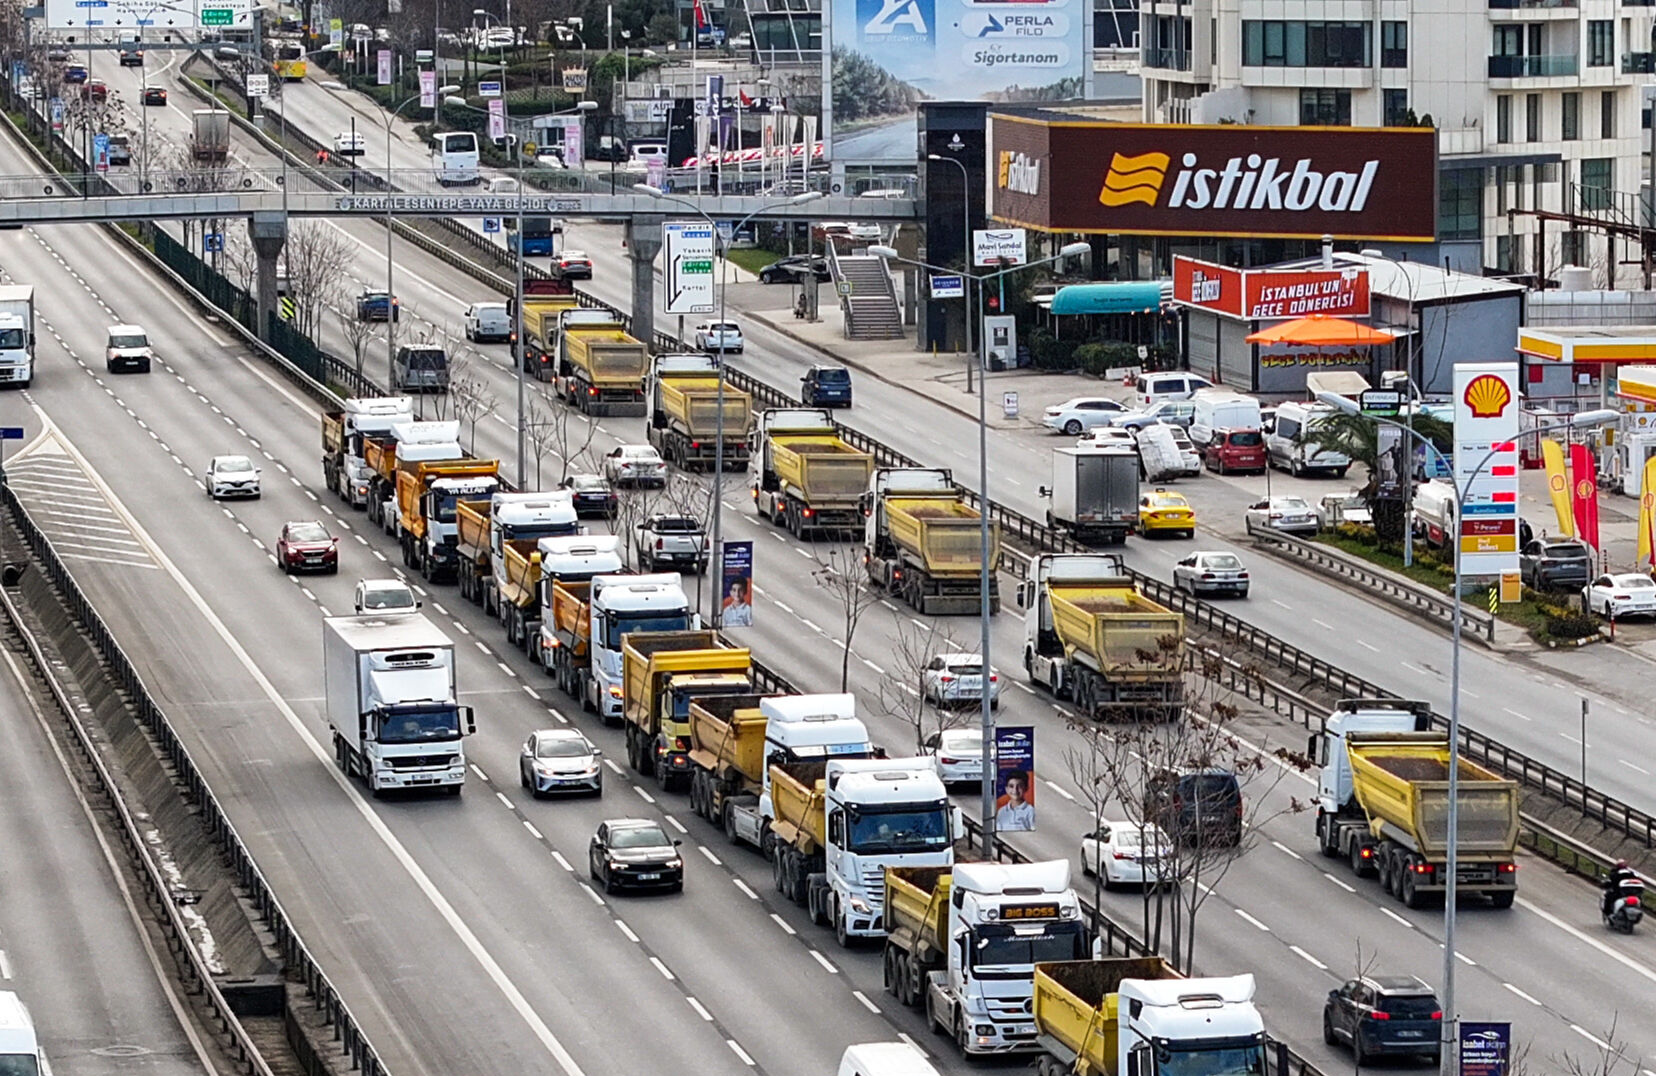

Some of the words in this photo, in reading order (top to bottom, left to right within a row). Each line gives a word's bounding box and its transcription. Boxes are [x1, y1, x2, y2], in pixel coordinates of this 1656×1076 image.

[1005, 16, 1053, 26] PERLA
[974, 52, 1058, 66] Sigortanom
[1009, 151, 1040, 195] istikbal
[1168, 153, 1379, 212] istikbal
[354, 198, 399, 209] KARTAL
[405, 198, 464, 209] ESENTEPE
[470, 198, 499, 209] YAYA
[978, 243, 997, 251] Mavi
[1261, 279, 1341, 302] İSTANBUL'UN
[1252, 303, 1284, 317] GECE
[1005, 909, 1023, 918] BIG
[1025, 907, 1055, 917] BOSS
